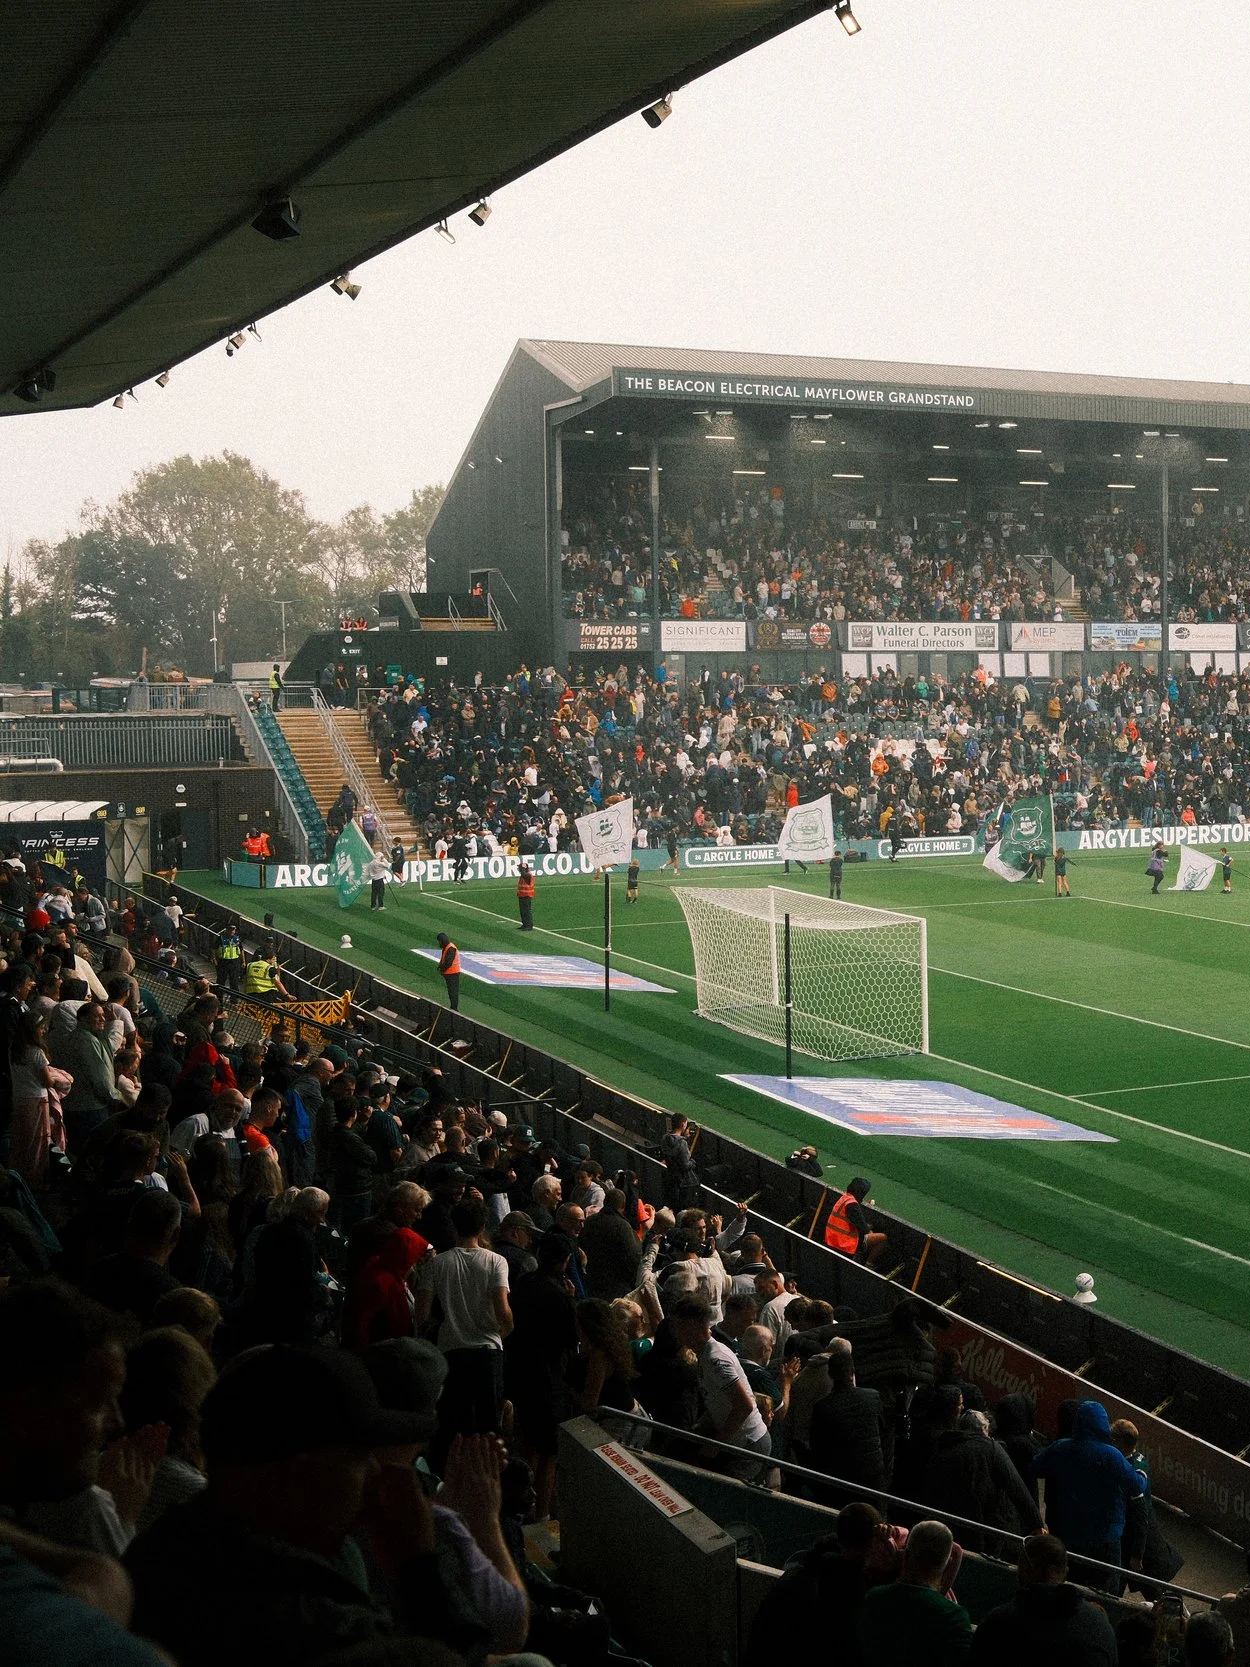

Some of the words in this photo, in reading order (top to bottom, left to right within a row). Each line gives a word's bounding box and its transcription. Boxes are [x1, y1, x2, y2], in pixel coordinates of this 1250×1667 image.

[625, 376, 653, 390] THE
[658, 378, 715, 394] BEACON
[720, 382, 801, 399] ELECTRICAL
[804, 386, 885, 403] MAYFLOWER
[888, 391, 975, 408] GRANDSTAND
[580, 623, 613, 636] TOWER
[613, 625, 638, 636] CABS
[666, 625, 742, 636] SIGNIFICANT
[852, 626, 872, 635] WCP
[876, 625, 914, 637] Walter
[918, 625, 929, 637] C.
[933, 625, 973, 637] Parson
[976, 627, 994, 636] WCP
[1032, 627, 1057, 638] MEP
[596, 637, 610, 650] 25
[610, 637, 624, 650] 25
[625, 637, 638, 650] 25
[883, 638, 919, 648] Funeral
[922, 638, 965, 648] Directors
[22, 837, 100, 848] RINCESS
[932, 840, 961, 852] HOME
[703, 849, 743, 863] ARGYLE
[744, 848, 775, 861] HOME
[1158, 1448, 1231, 1515] learning
